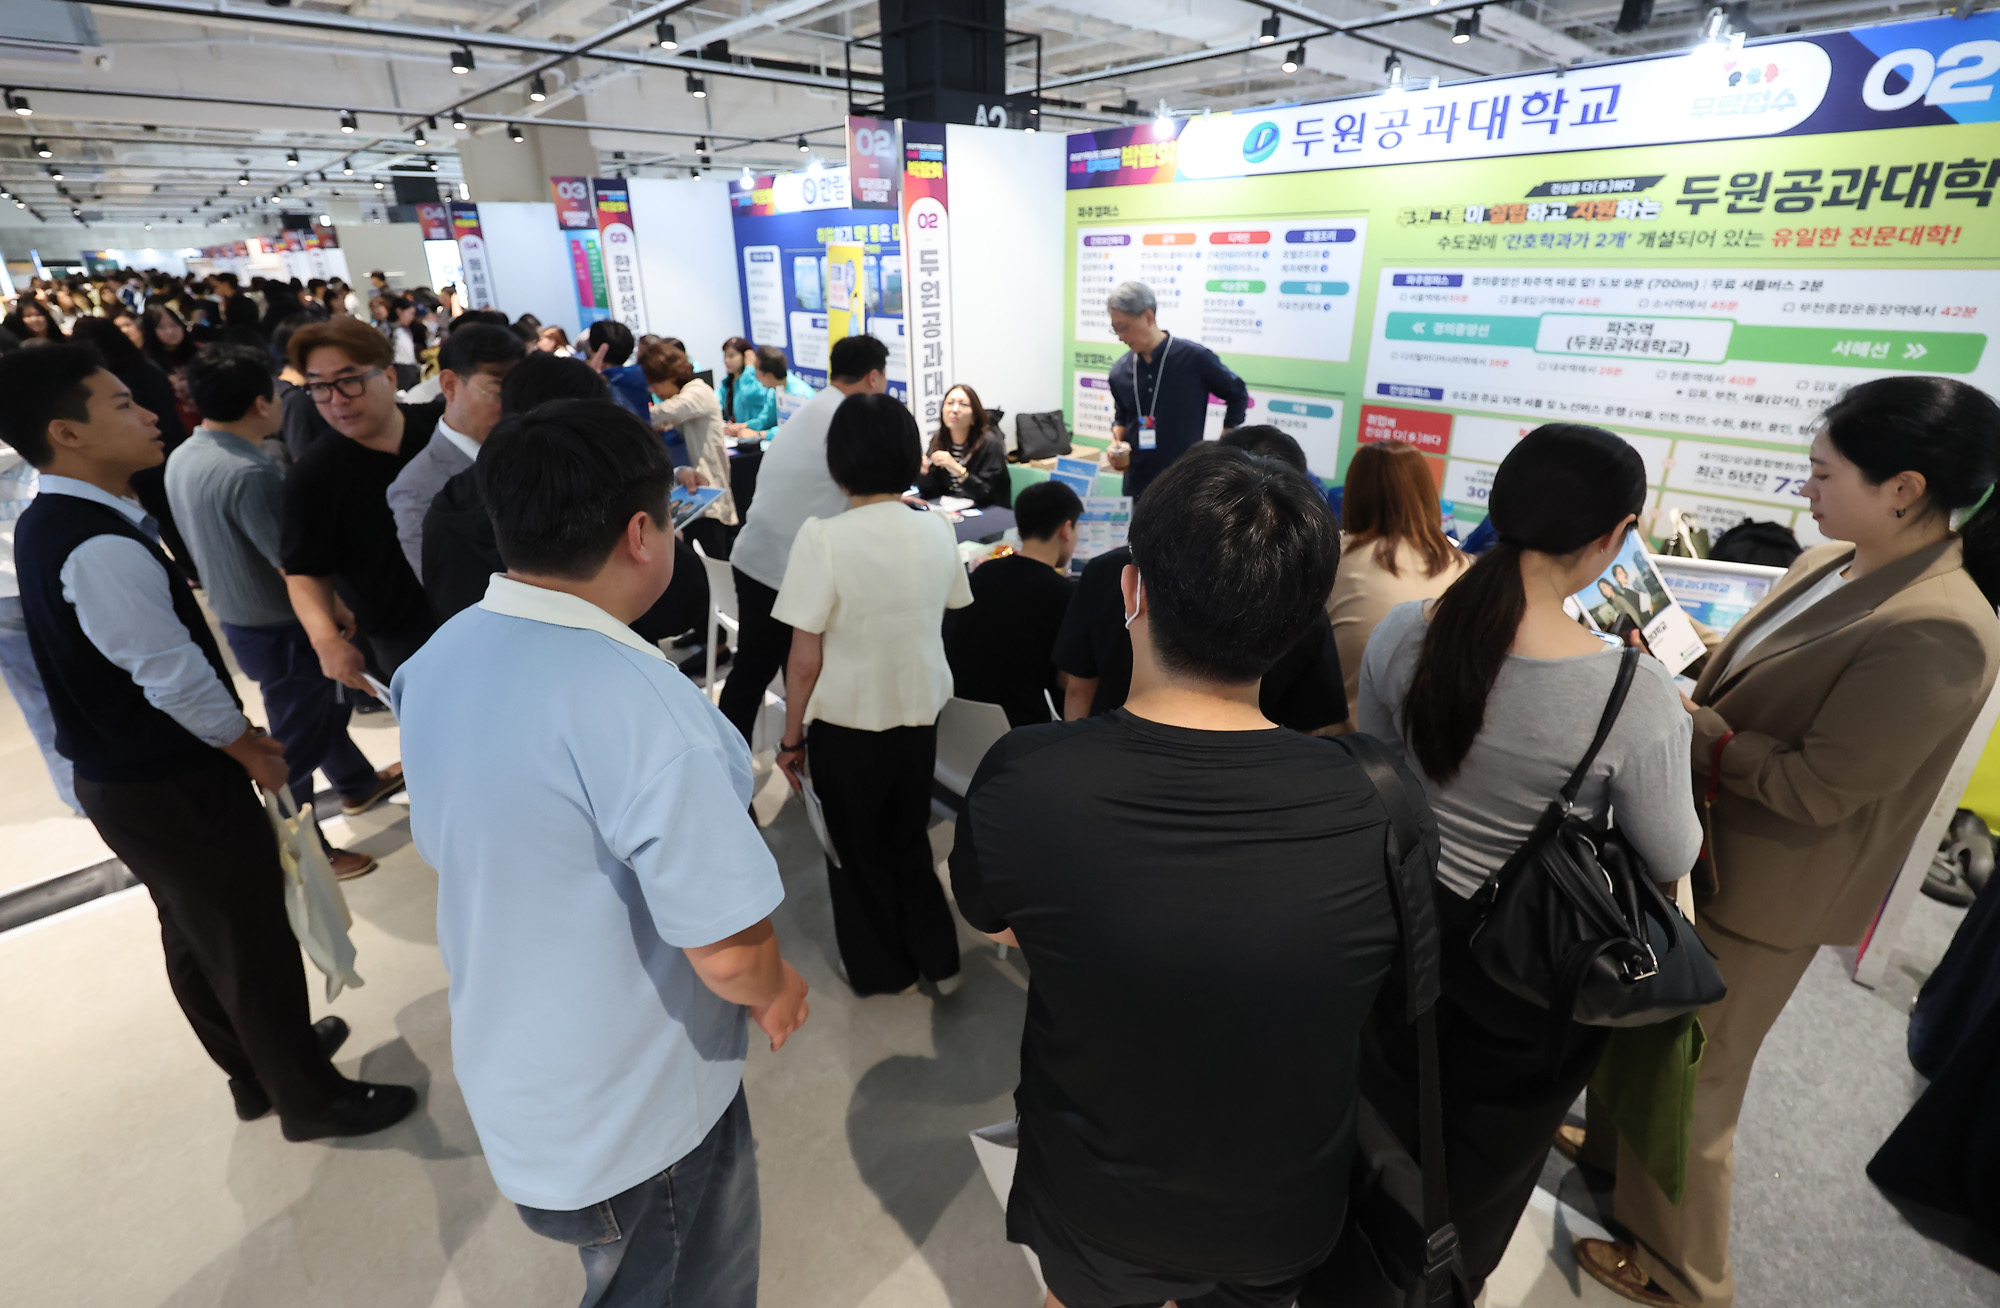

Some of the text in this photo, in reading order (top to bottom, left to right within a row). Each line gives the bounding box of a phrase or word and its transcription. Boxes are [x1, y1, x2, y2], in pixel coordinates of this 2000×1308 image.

[1862, 38, 2000, 112] 02
[1291, 83, 1622, 157] 두원공과대학교
[856, 128, 892, 158] 02
[557, 181, 587, 199] 03
[1676, 156, 2000, 216] 두원공과대학
[917, 213, 938, 229] 02
[1488, 201, 1568, 224] 설립하고
[1571, 198, 1663, 222] 지원하는
[1437, 234, 1498, 251] 수도권에
[1636, 229, 1717, 249] 개설되어
[1722, 228, 1765, 248] 있는
[1771, 226, 1842, 249] 유일한
[1848, 223, 1963, 248] 전문대학!
[1940, 305, 1978, 319] 42분
[1606, 321, 1655, 337] 파주역
[920, 249, 944, 436] 두원공과대학
[1831, 340, 1891, 360] 서해선
[1696, 464, 1724, 480] 최근
